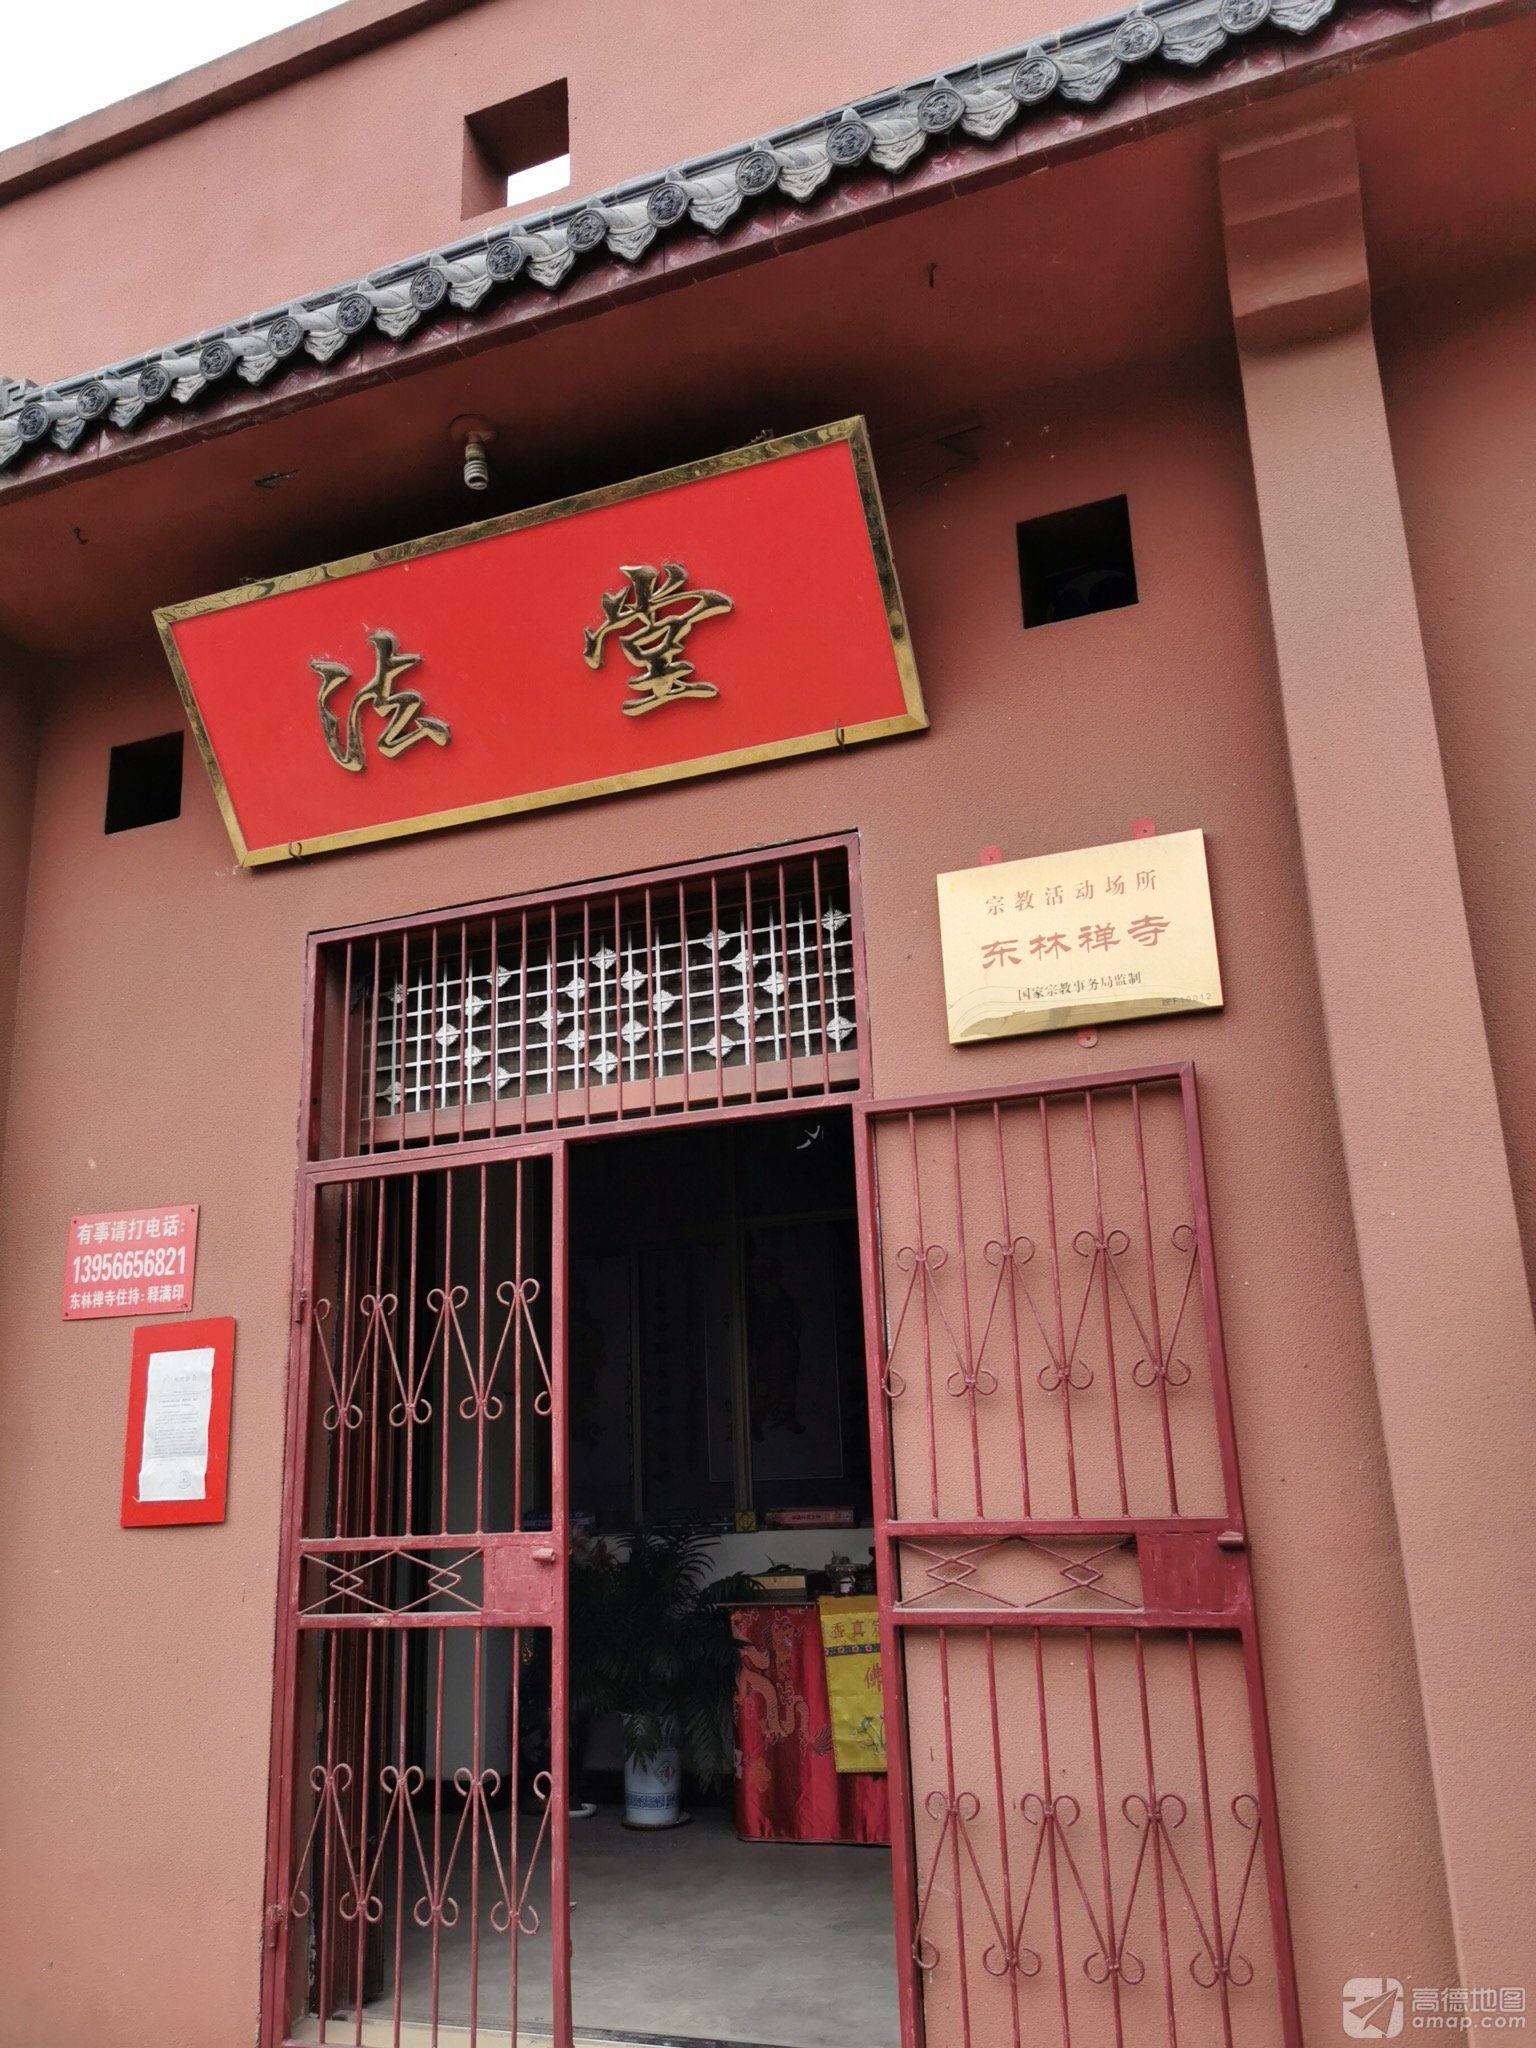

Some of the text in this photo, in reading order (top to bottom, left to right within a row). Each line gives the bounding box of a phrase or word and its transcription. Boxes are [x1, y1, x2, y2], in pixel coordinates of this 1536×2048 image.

[309, 563, 734, 772] 法堂
[985, 869, 1157, 916] 宗教活动场所
[981, 914, 1171, 969] 东林禅寺
[1017, 971, 1142, 1001] 国家宗教事务局监制
[73, 1246, 186, 1284] 13956656821
